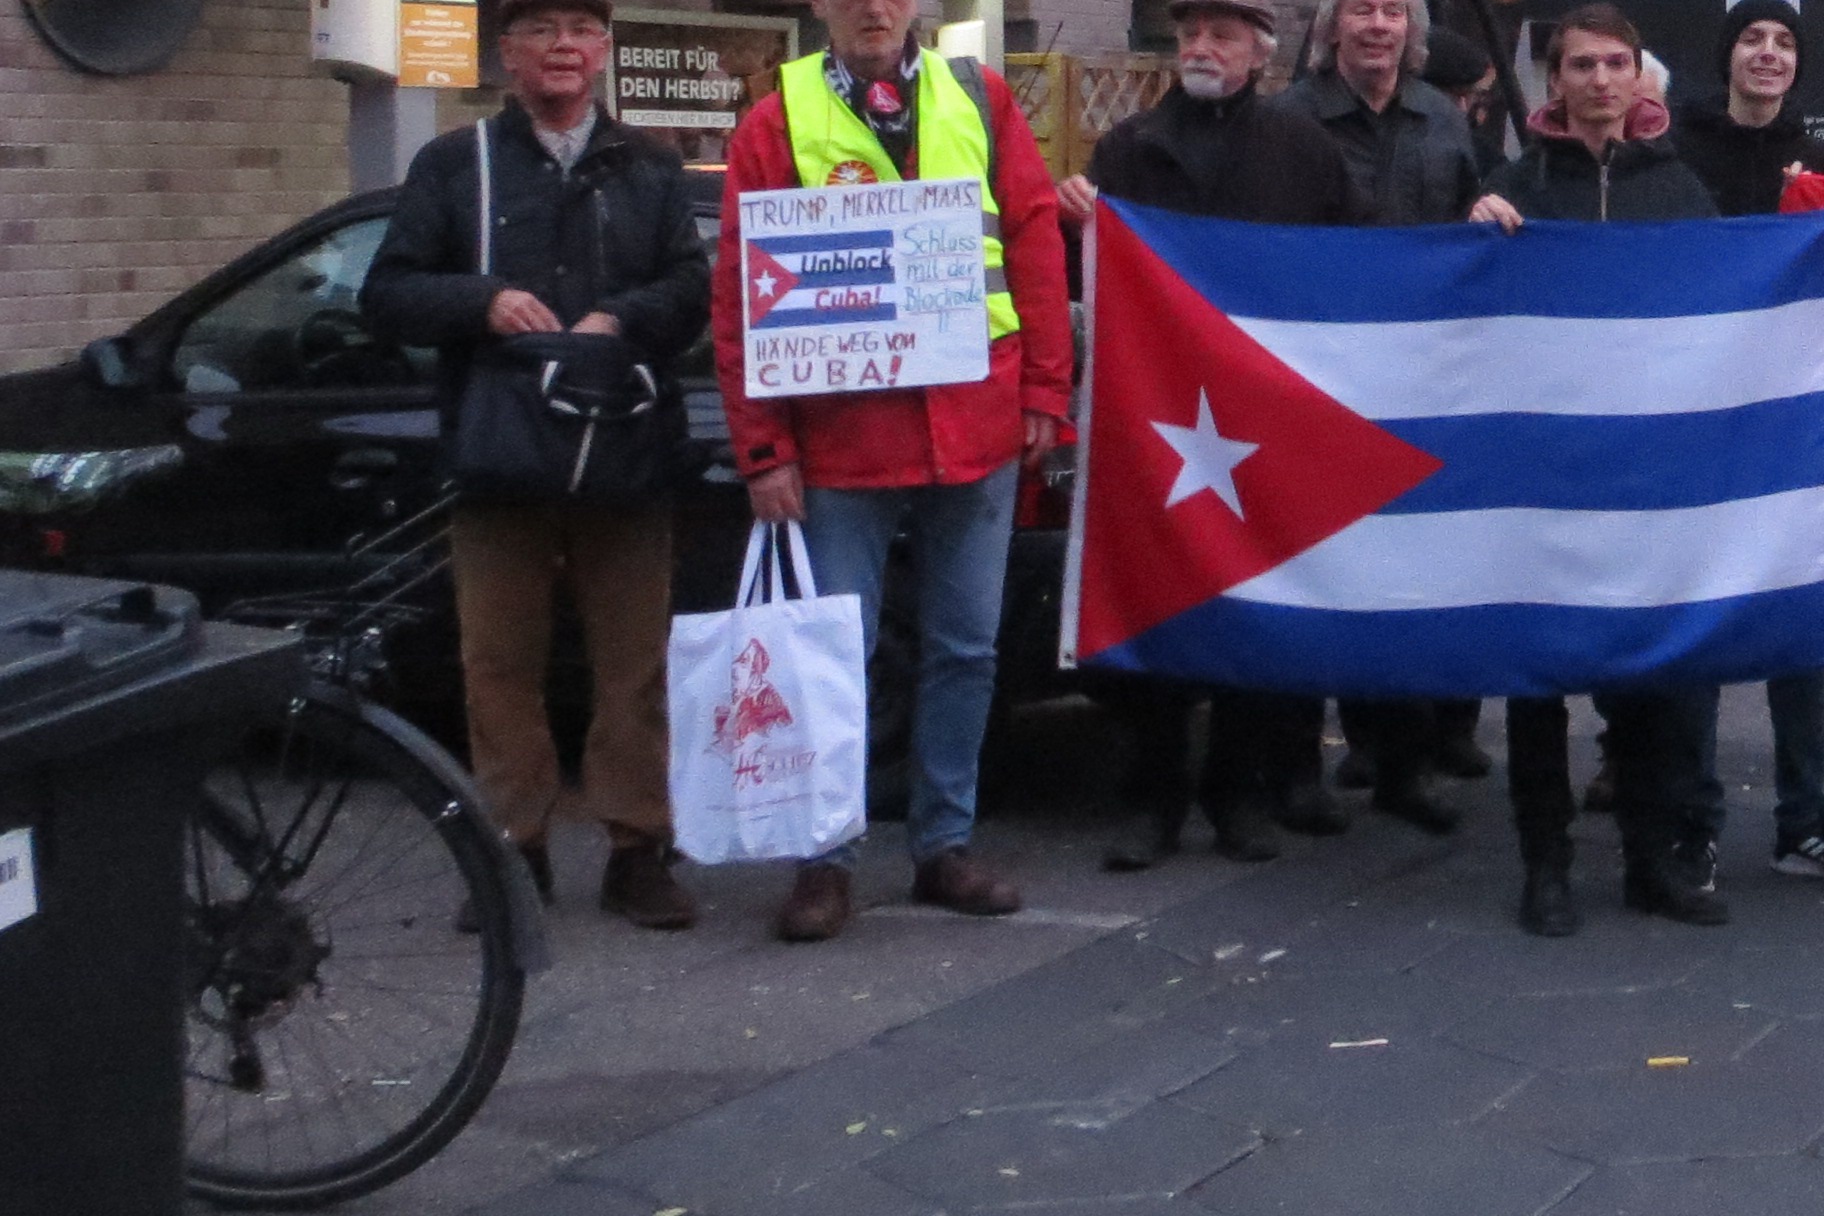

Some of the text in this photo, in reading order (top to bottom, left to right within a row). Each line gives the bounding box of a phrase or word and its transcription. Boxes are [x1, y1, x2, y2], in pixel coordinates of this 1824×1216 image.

[619, 45, 720, 71] BEREIT FÜR
[620, 77, 740, 100] DEN HERBST?
[742, 195, 834, 228] TRUMP,
[801, 248, 891, 275] Unblock
[814, 286, 881, 310] Cuba!
[756, 335, 830, 361] HÄNDE
[838, 333, 878, 353] WEG
[758, 355, 902, 386] CUBA!
